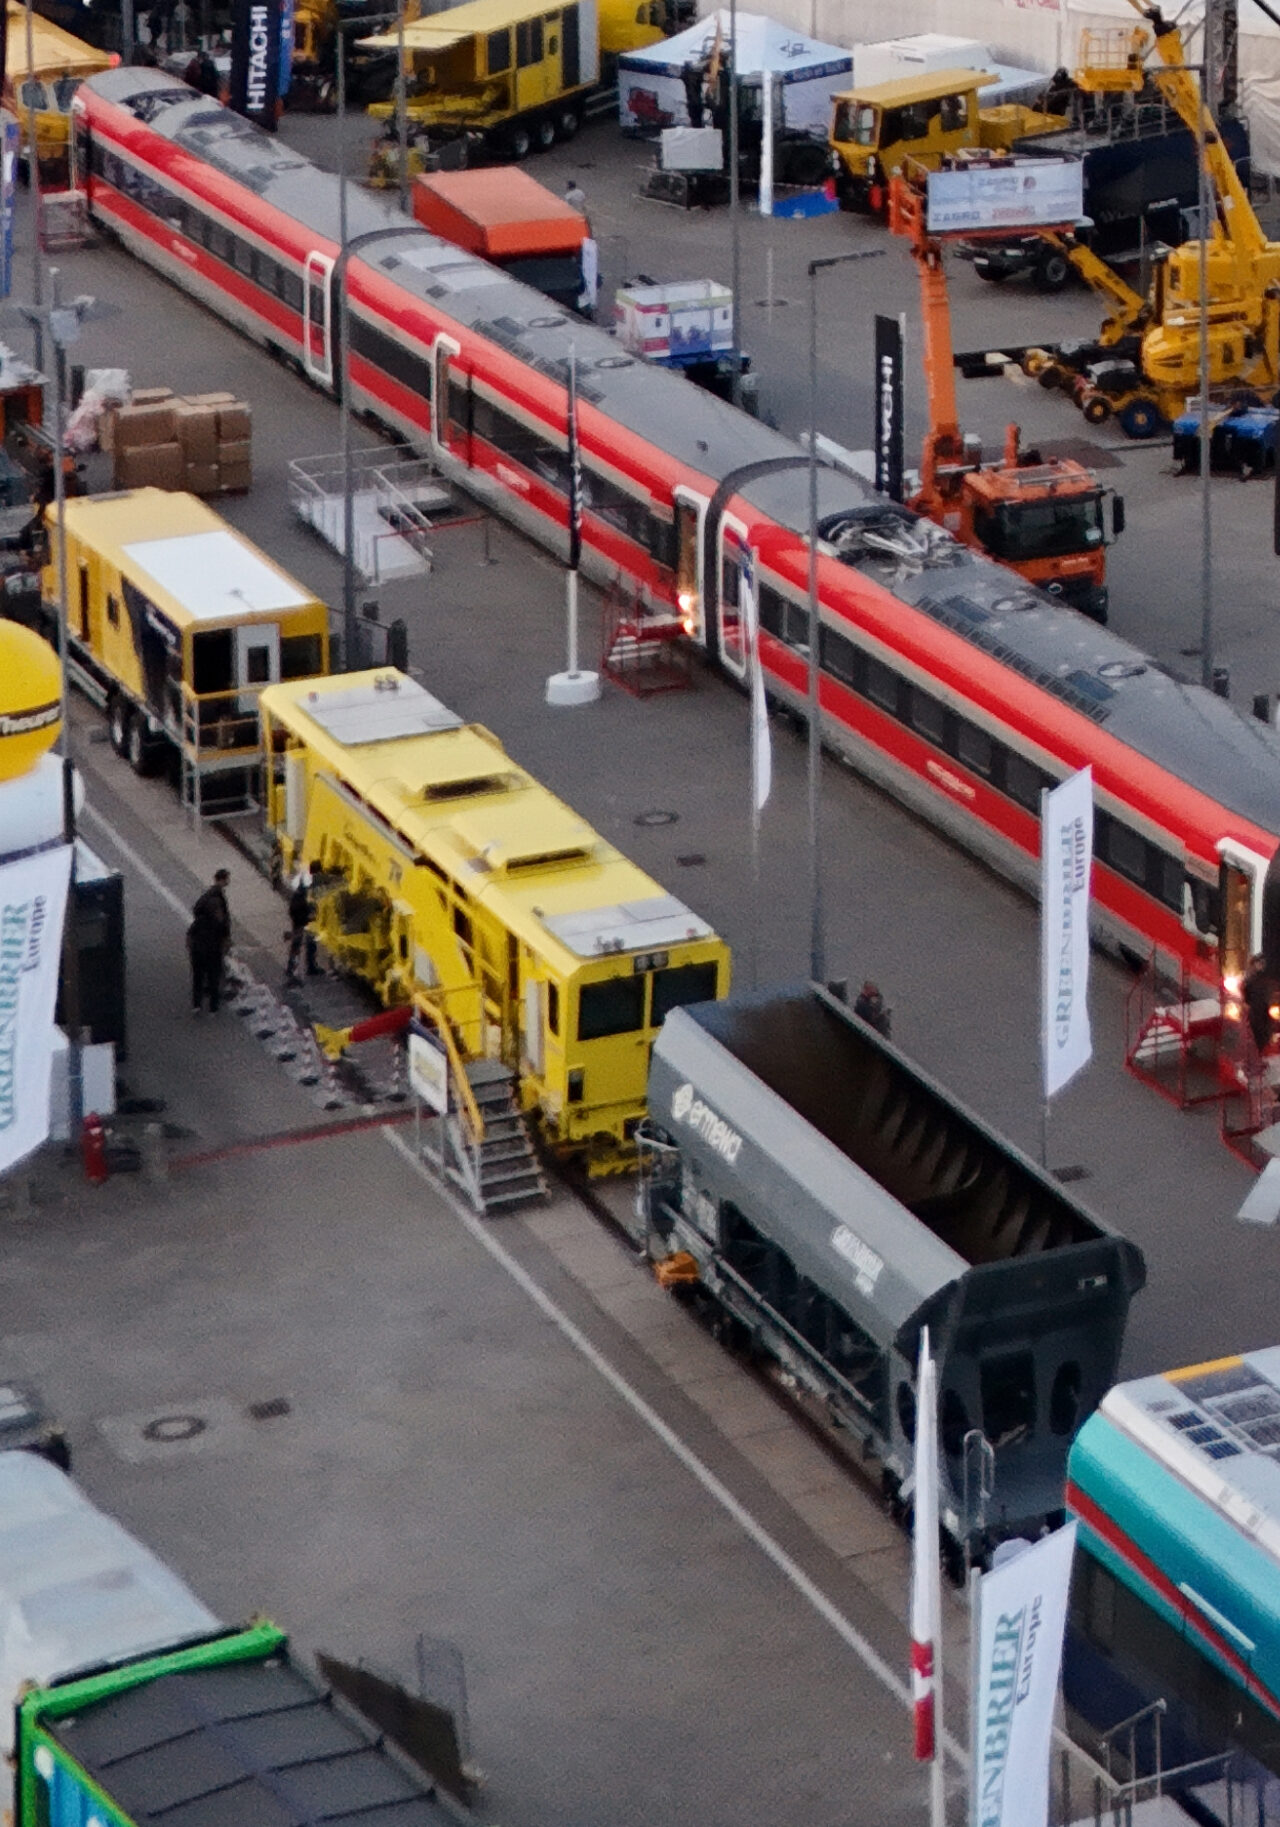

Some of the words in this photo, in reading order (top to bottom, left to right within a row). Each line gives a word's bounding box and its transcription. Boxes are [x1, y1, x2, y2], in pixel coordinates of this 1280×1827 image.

[246, 5, 269, 110] HITACHI
[1073, 816, 1085, 893] Europe
[21, 895, 46, 973] Europe
[689, 1100, 743, 1164] ermewa
[1015, 1594, 1043, 1706] Europe
